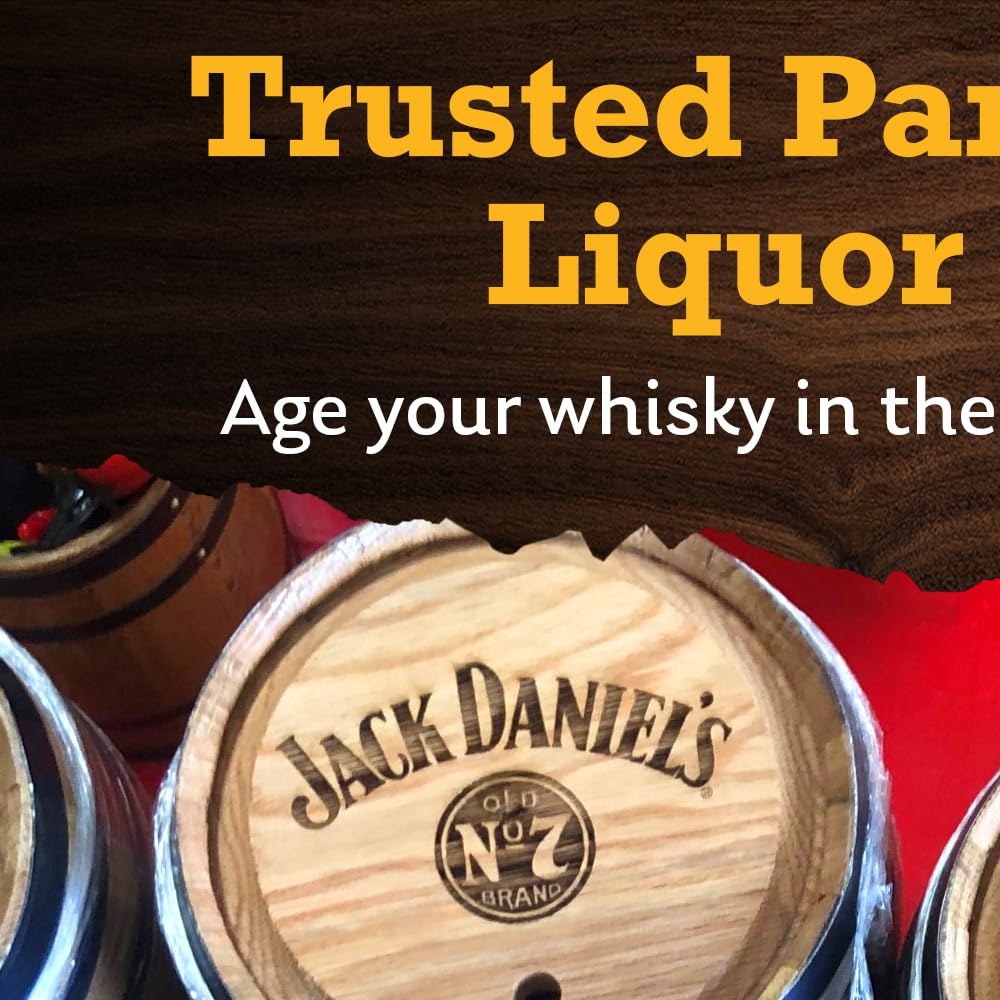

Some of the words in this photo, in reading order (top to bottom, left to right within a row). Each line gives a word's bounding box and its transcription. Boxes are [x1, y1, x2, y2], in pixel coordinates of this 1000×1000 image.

[275, 693, 457, 831] JACK
[453, 660, 733, 789] DANIEL'S
[481, 883, 562, 910] BRAND
